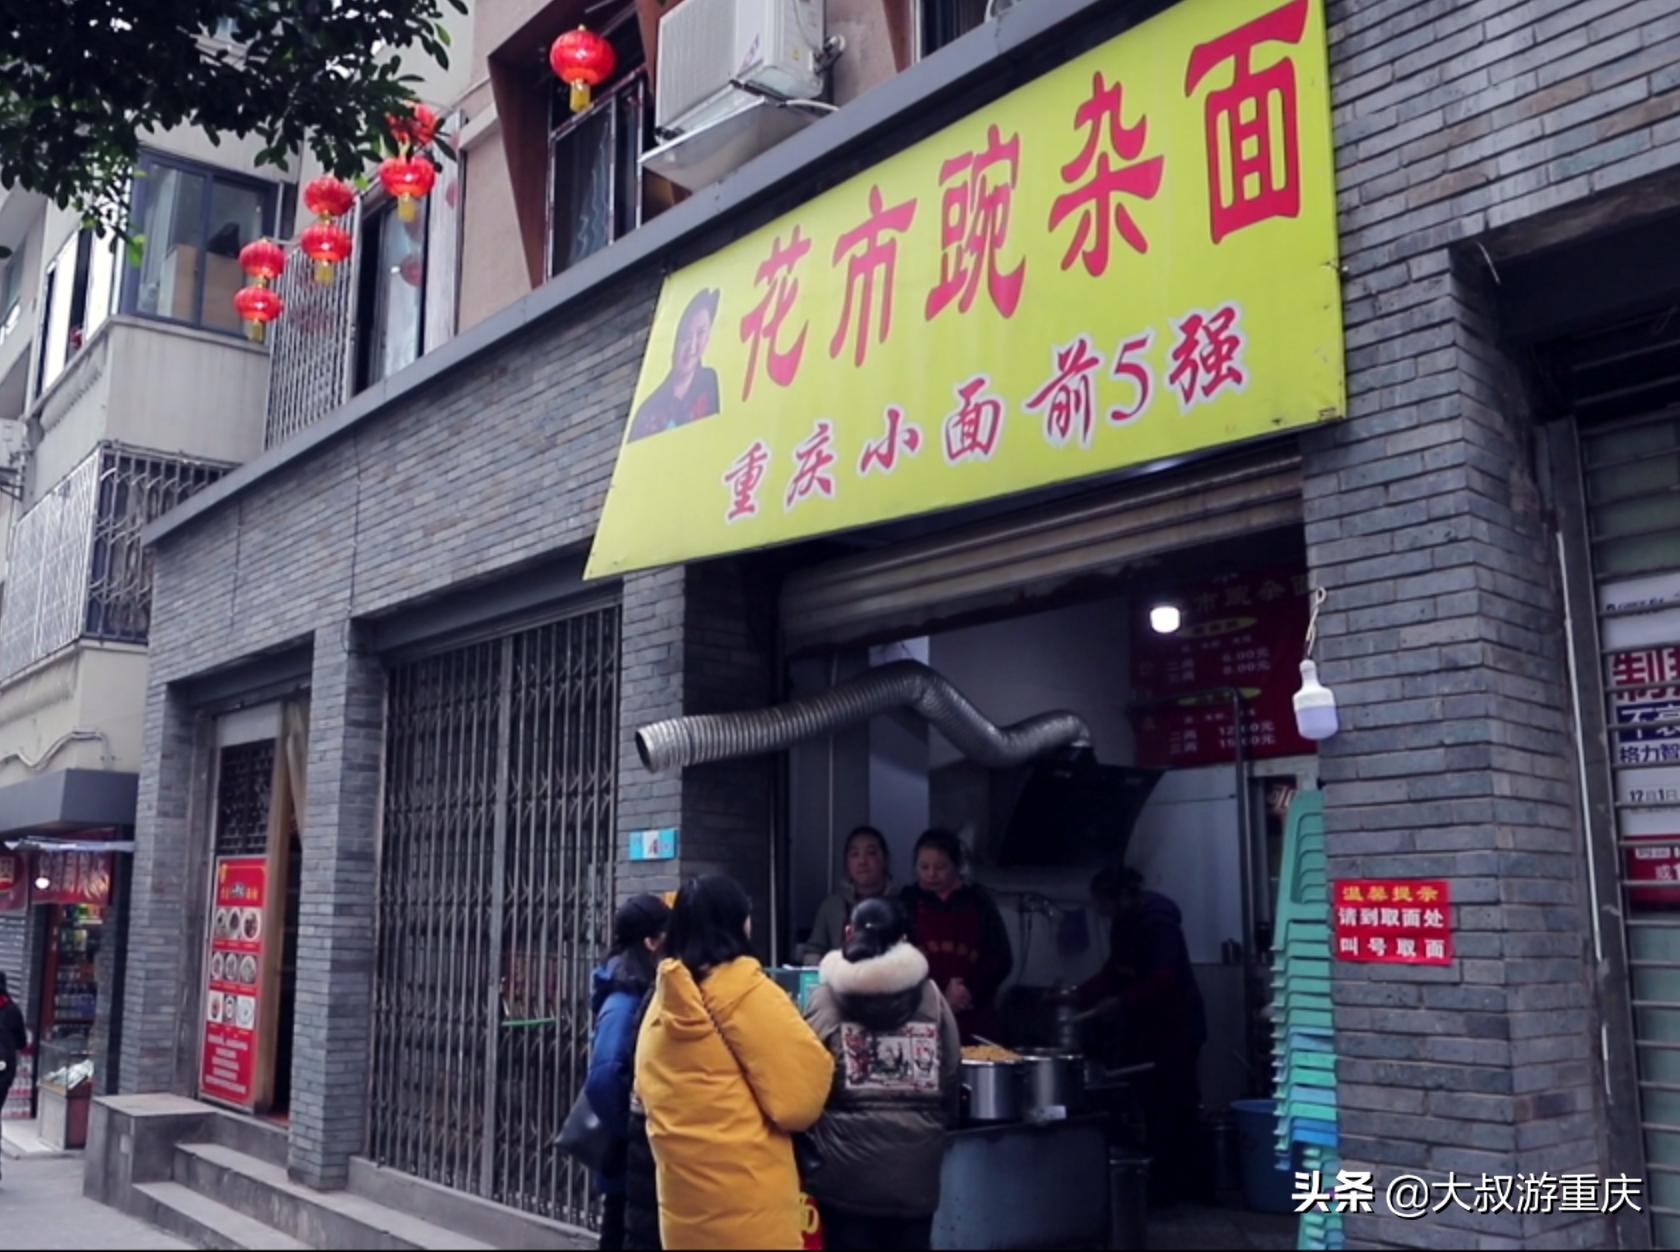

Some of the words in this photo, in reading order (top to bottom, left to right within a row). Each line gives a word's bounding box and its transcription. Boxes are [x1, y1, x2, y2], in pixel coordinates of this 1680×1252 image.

[739, 0, 1308, 402] 花市豌杂面
[724, 307, 1245, 521] 重庆小面前5强
[1342, 885, 1440, 902] 温馨提示
[1338, 907, 1444, 928] 请到取面处
[1339, 935, 1445, 958] 叫号取面
